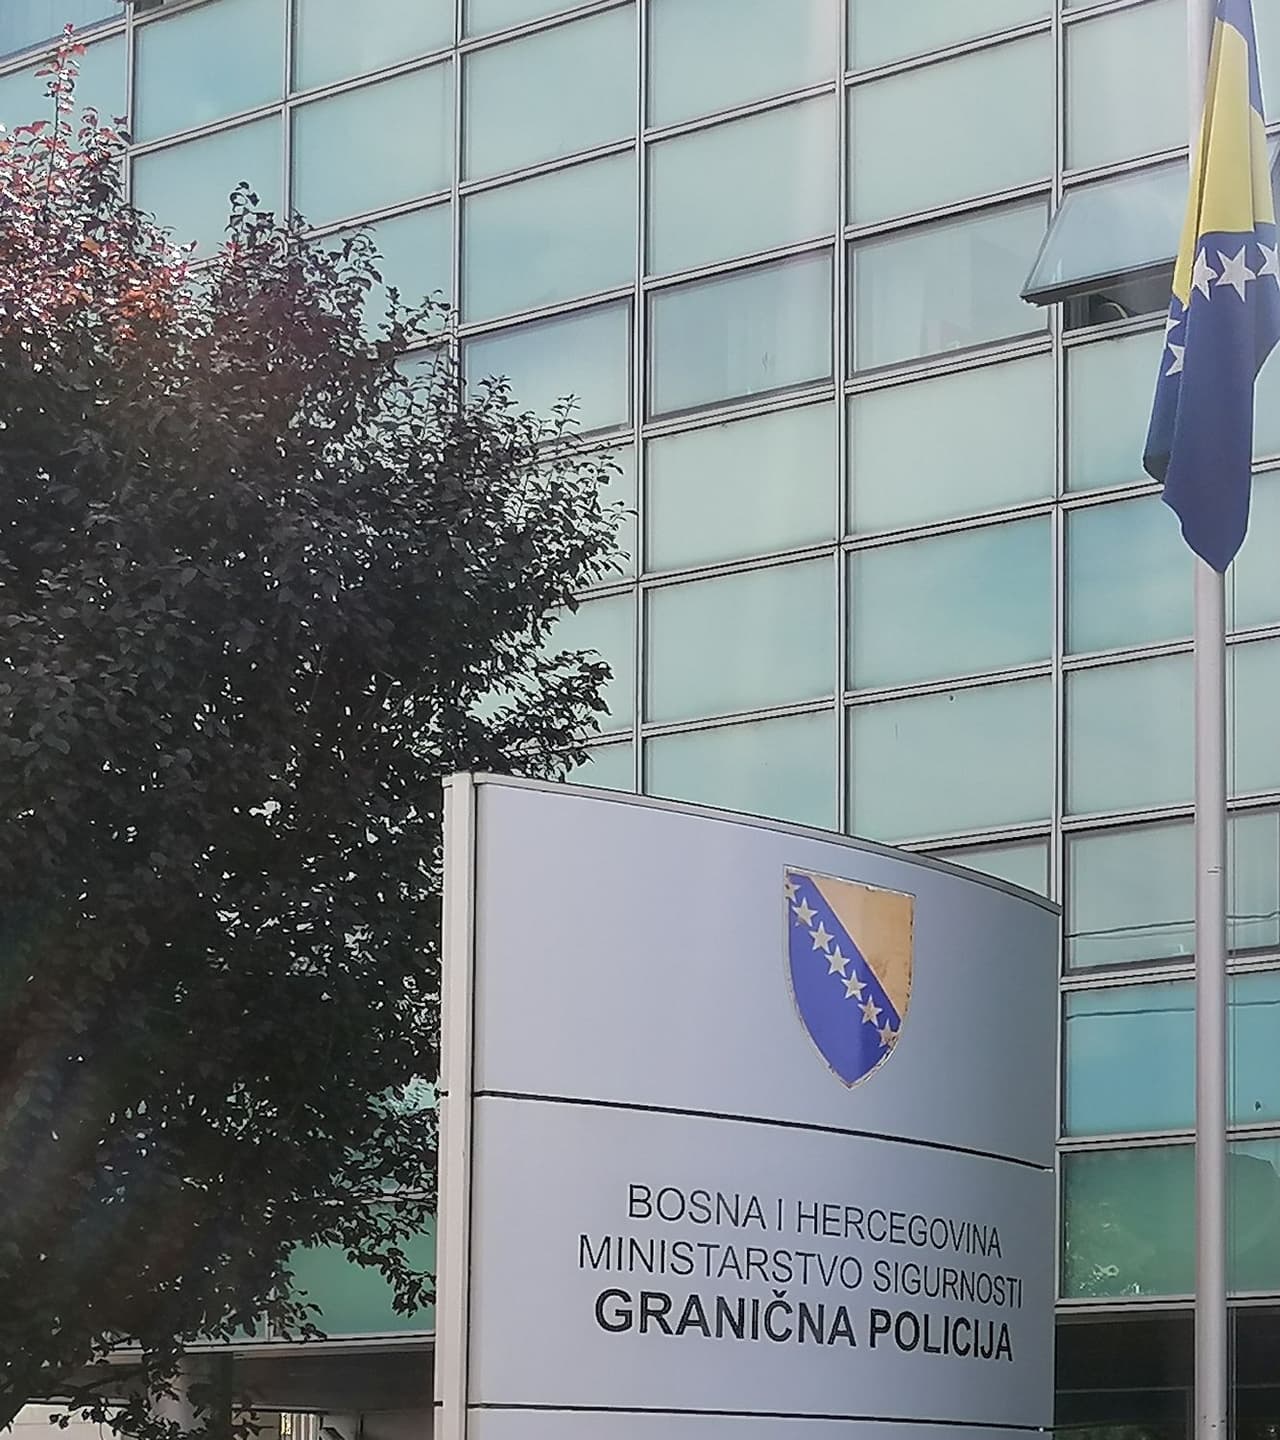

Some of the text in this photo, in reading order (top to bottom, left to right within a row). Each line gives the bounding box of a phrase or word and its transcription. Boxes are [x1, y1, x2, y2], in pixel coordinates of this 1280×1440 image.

[628, 1184, 1002, 1258] BOSNA I HERCEGOVINA
[578, 1234, 1023, 1309] MINISTARSTVO SIGURNOSTI
[595, 1288, 1014, 1362] GRANIČNA POLICIJA
